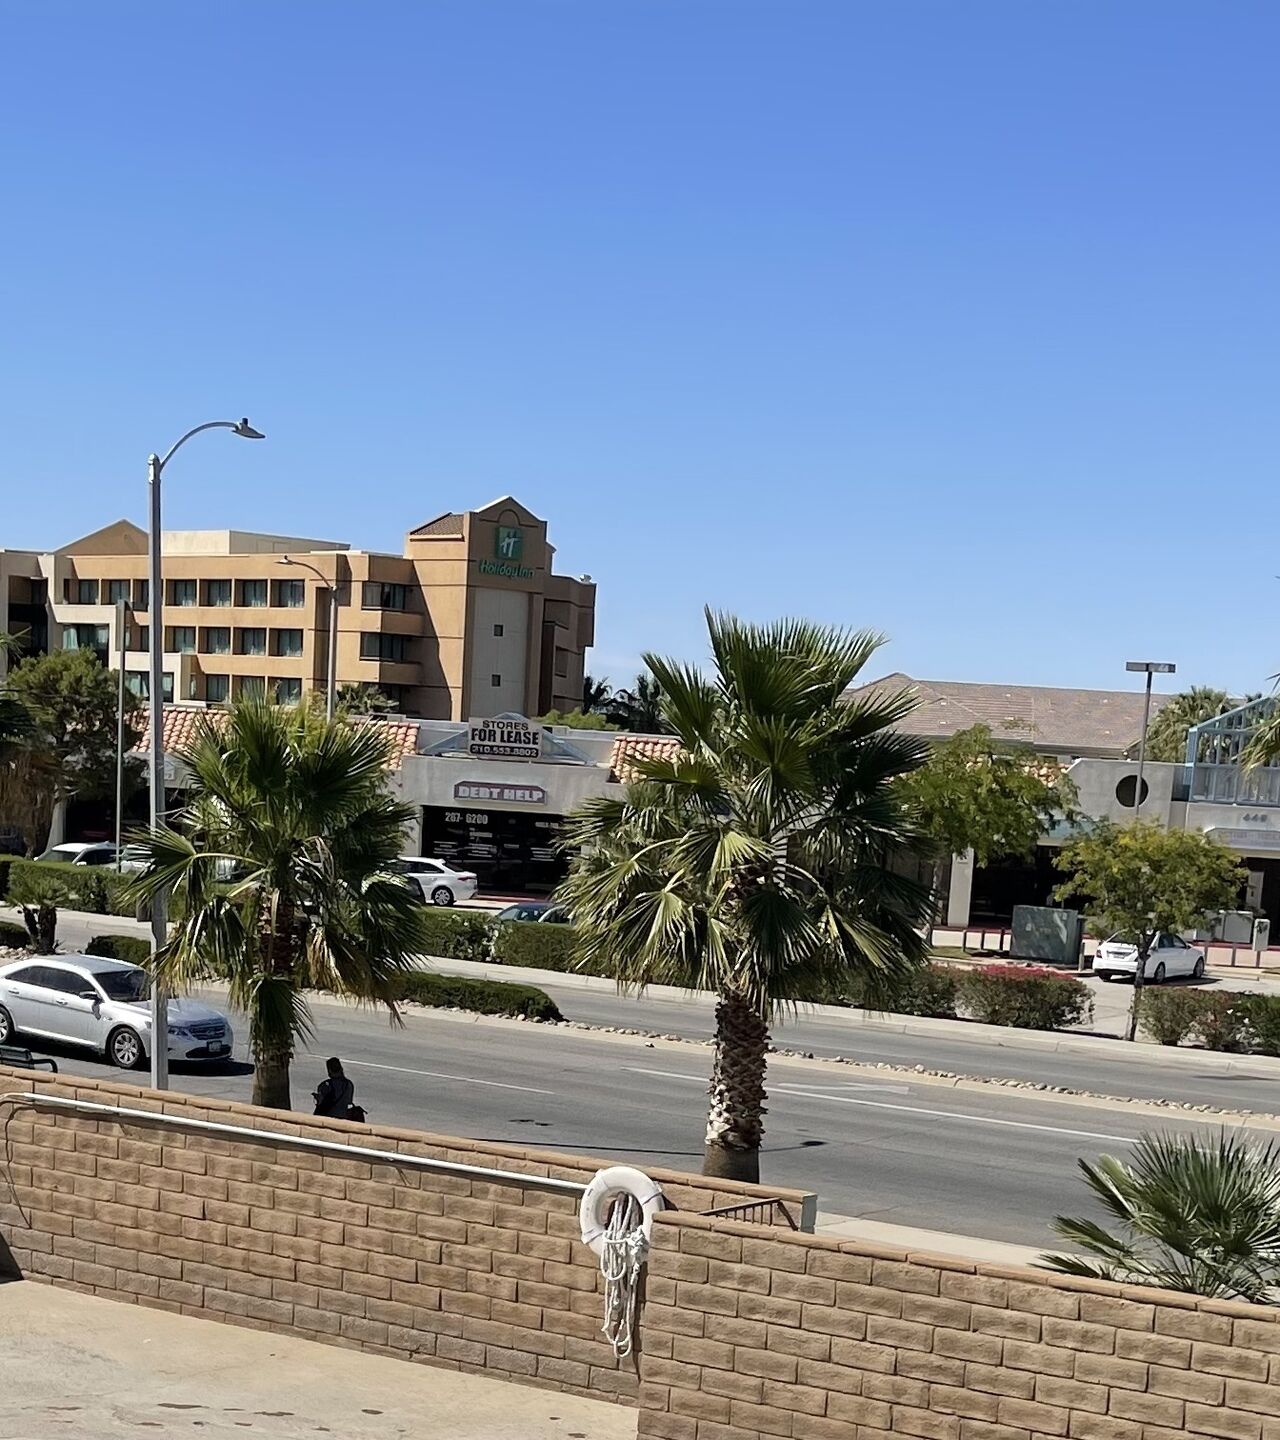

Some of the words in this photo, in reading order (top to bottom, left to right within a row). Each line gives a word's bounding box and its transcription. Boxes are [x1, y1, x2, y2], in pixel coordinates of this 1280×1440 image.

[480, 560, 519, 579] Holiday
[520, 564, 535, 577] Inn
[482, 720, 529, 731] STORES
[471, 728, 496, 742] FOR
[500, 730, 539, 745] LEASE
[458, 785, 501, 799] DEBT
[503, 788, 544, 801] HELP
